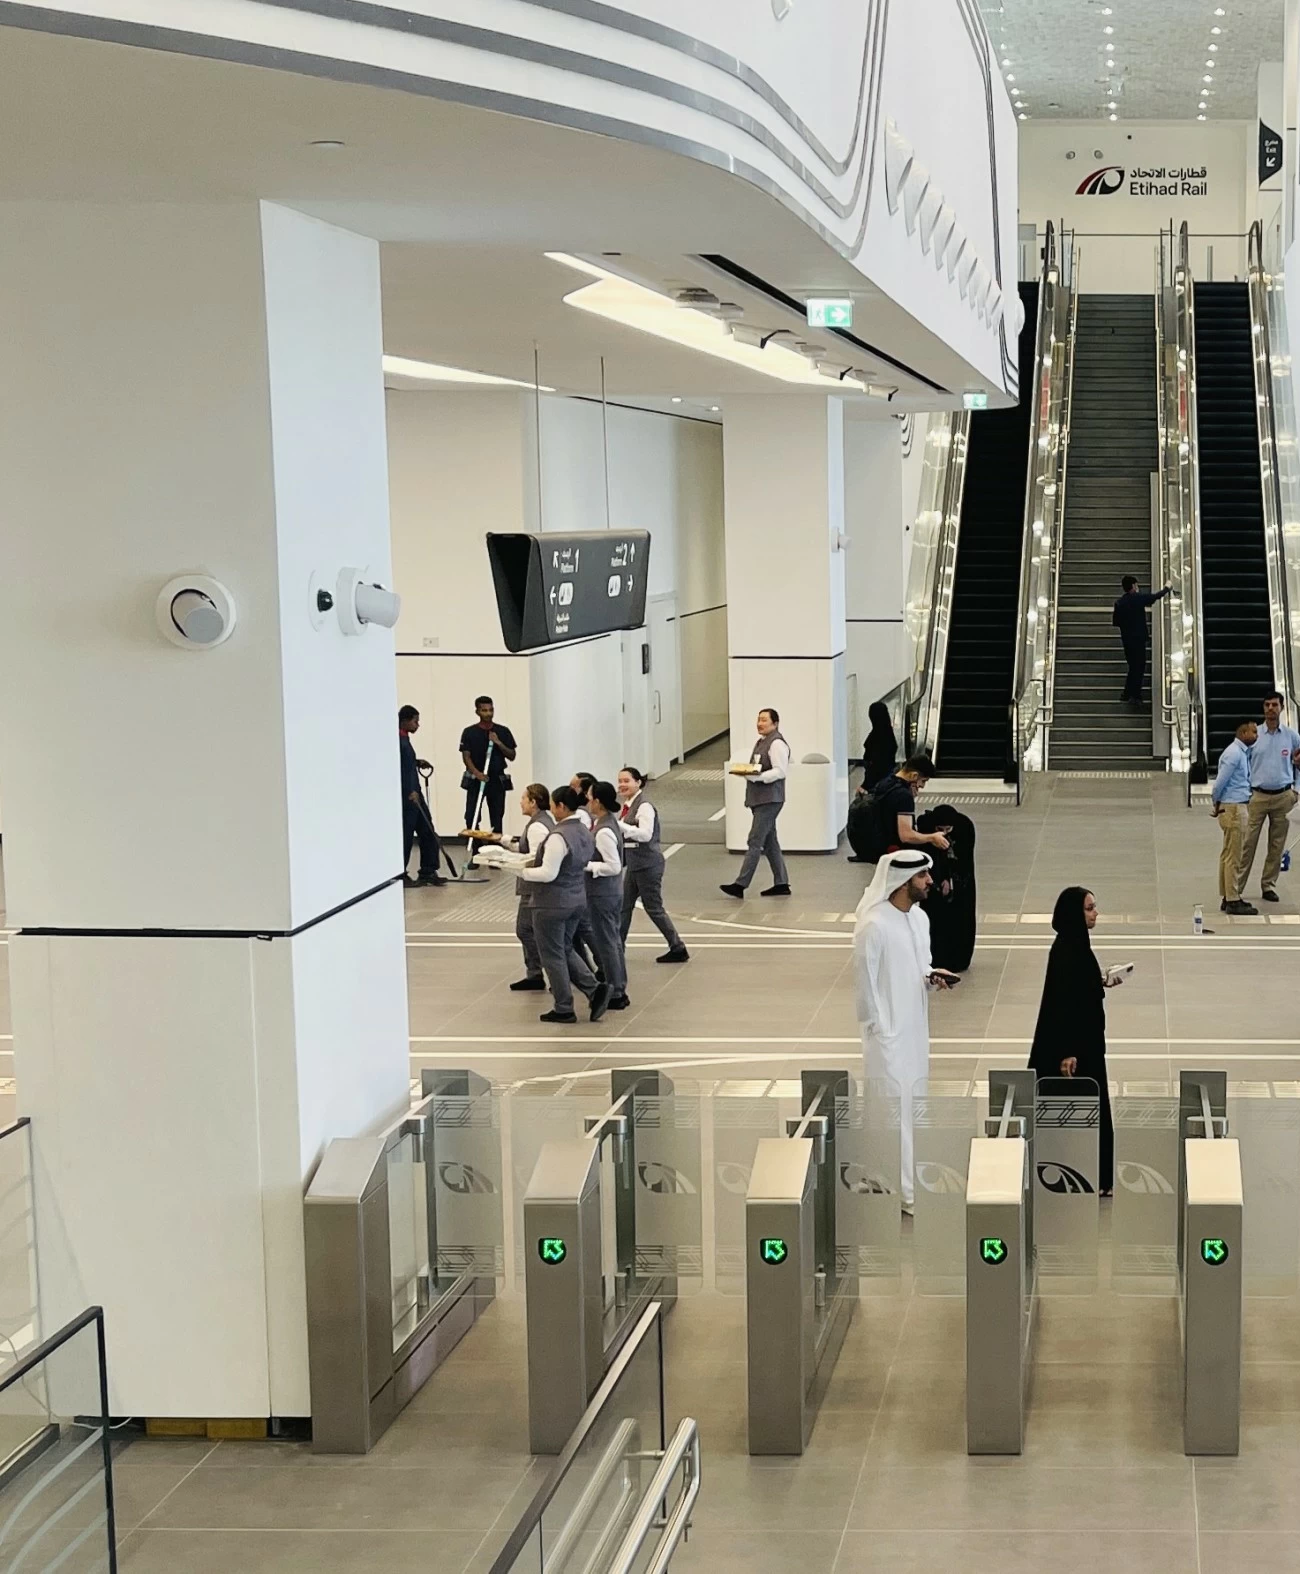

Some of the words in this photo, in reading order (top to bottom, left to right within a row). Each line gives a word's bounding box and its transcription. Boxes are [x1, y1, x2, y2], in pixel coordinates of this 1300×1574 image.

[1130, 167, 1166, 178] الاتحاد
[1168, 166, 1207, 180] قطارات
[1130, 182, 1178, 195] Etihad
[1181, 182, 1207, 195] Rail
